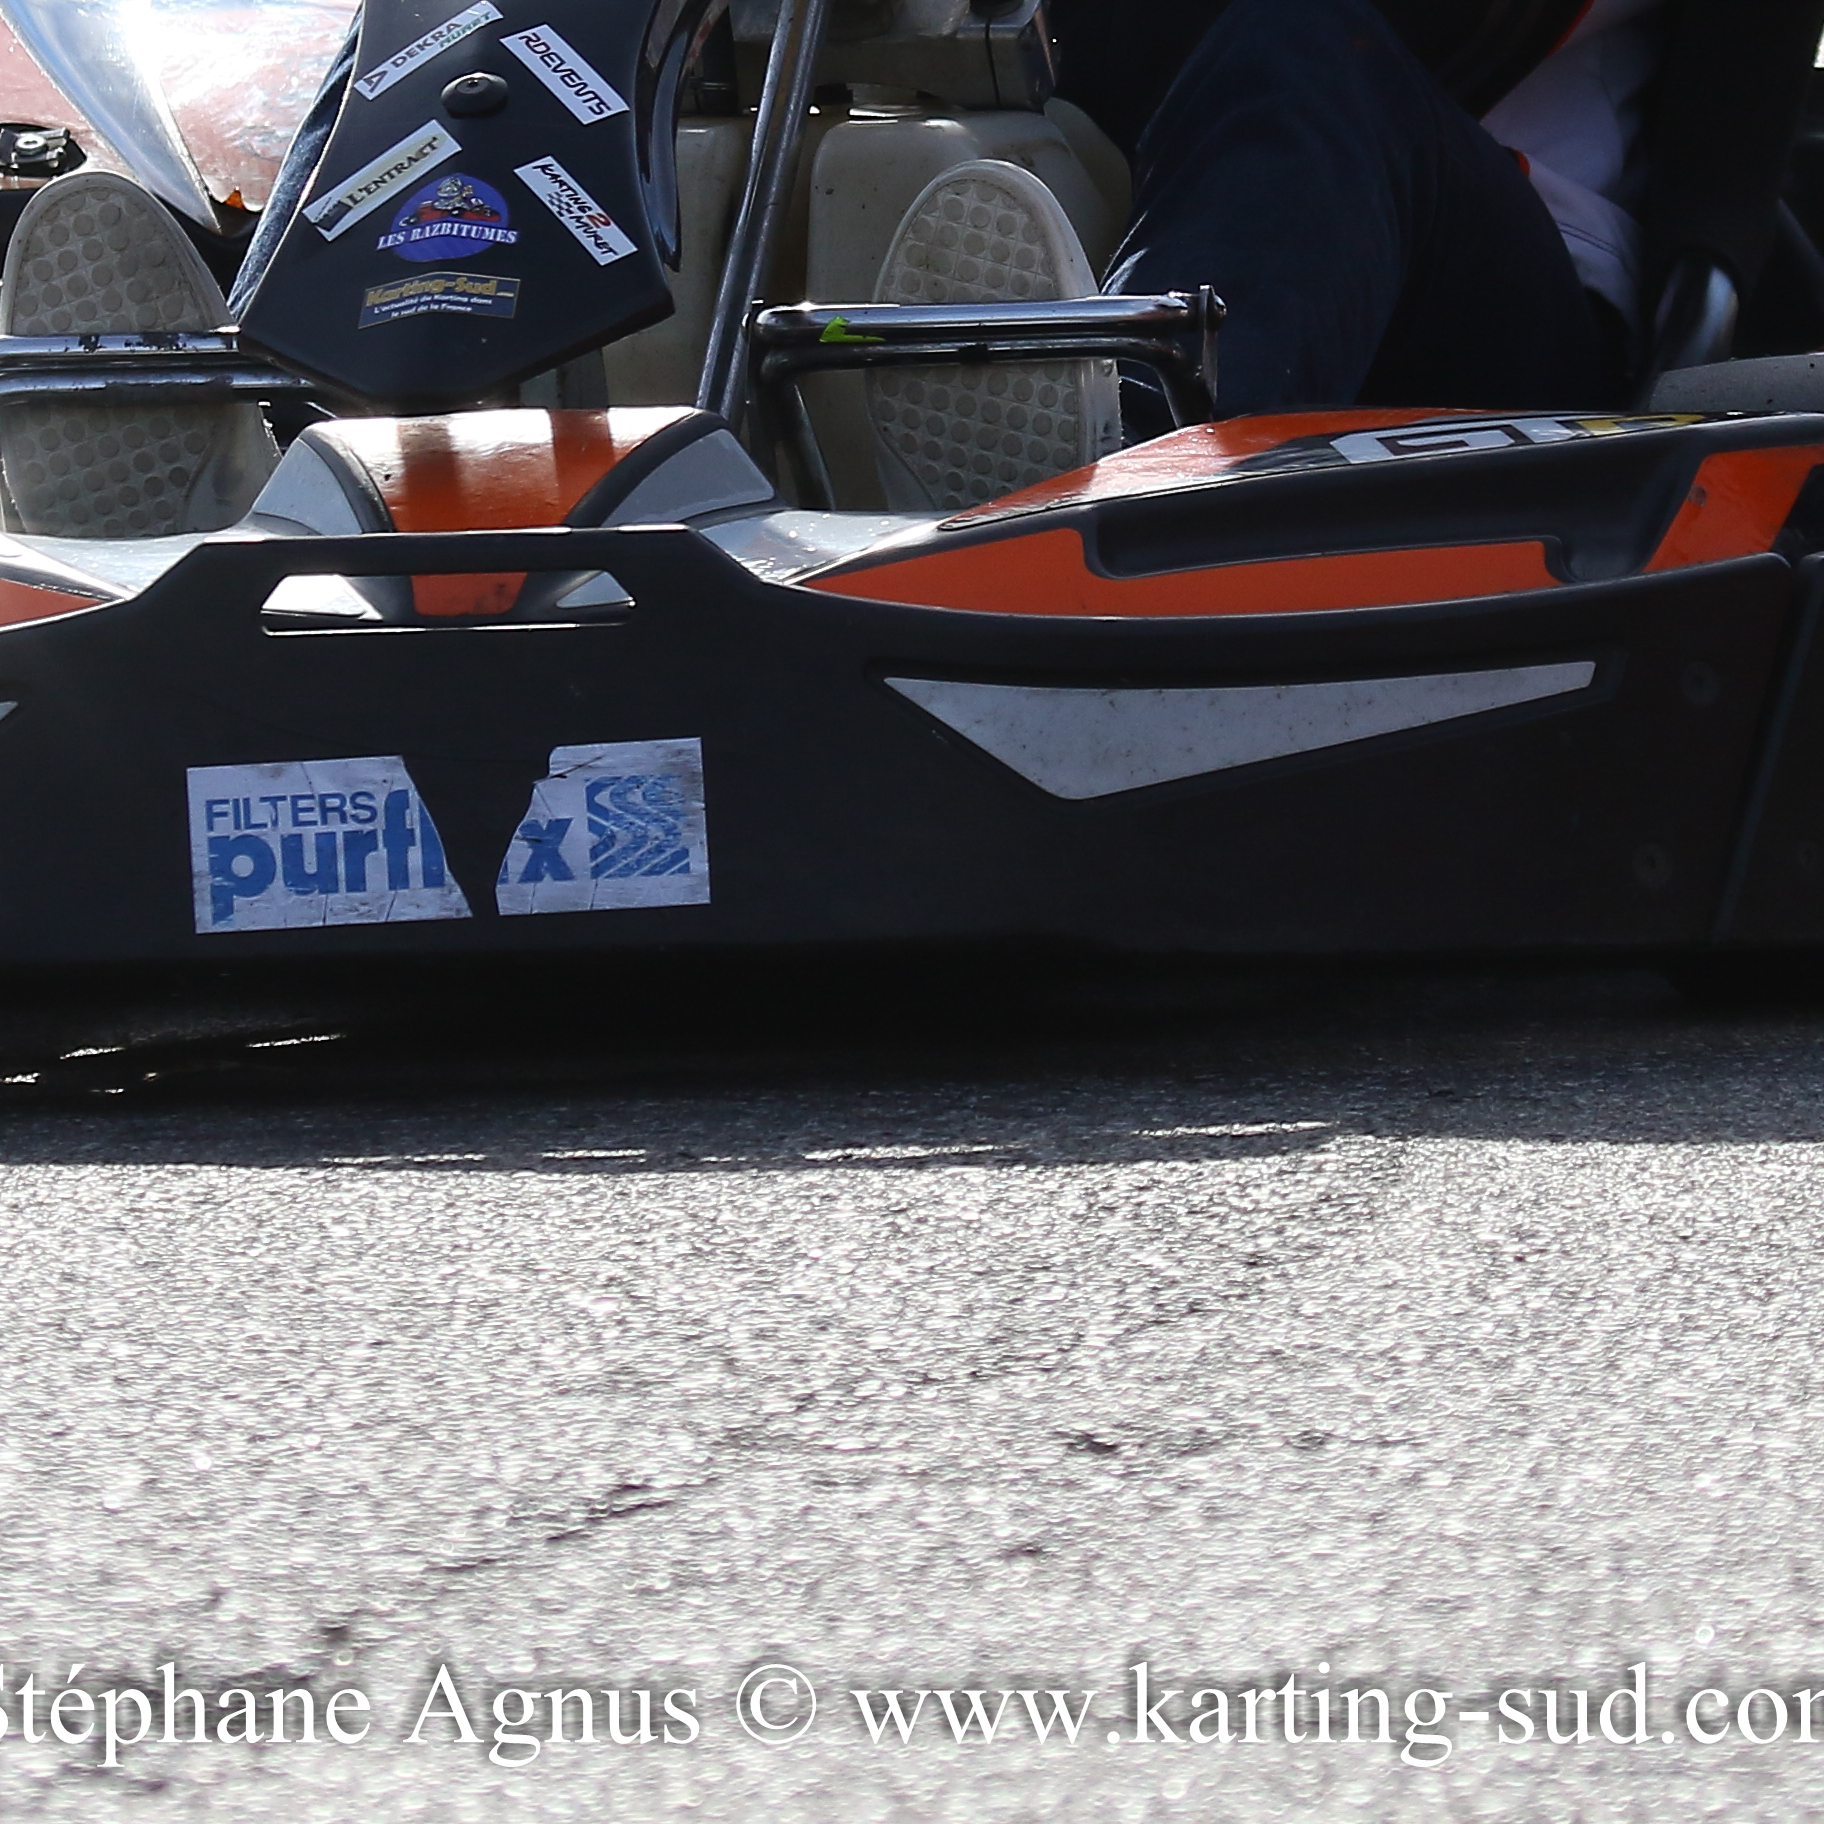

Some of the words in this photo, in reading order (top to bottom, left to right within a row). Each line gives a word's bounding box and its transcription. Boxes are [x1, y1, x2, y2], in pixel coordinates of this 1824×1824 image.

[391, 20, 464, 68] DEKRA
[531, 163, 594, 216] KARTING
[587, 212, 612, 229] 2
[377, 231, 406, 251] LES
[409, 222, 520, 246] RAZBITUMES
[566, 213, 619, 257] MURET
[205, 791, 376, 832] FILTERS
